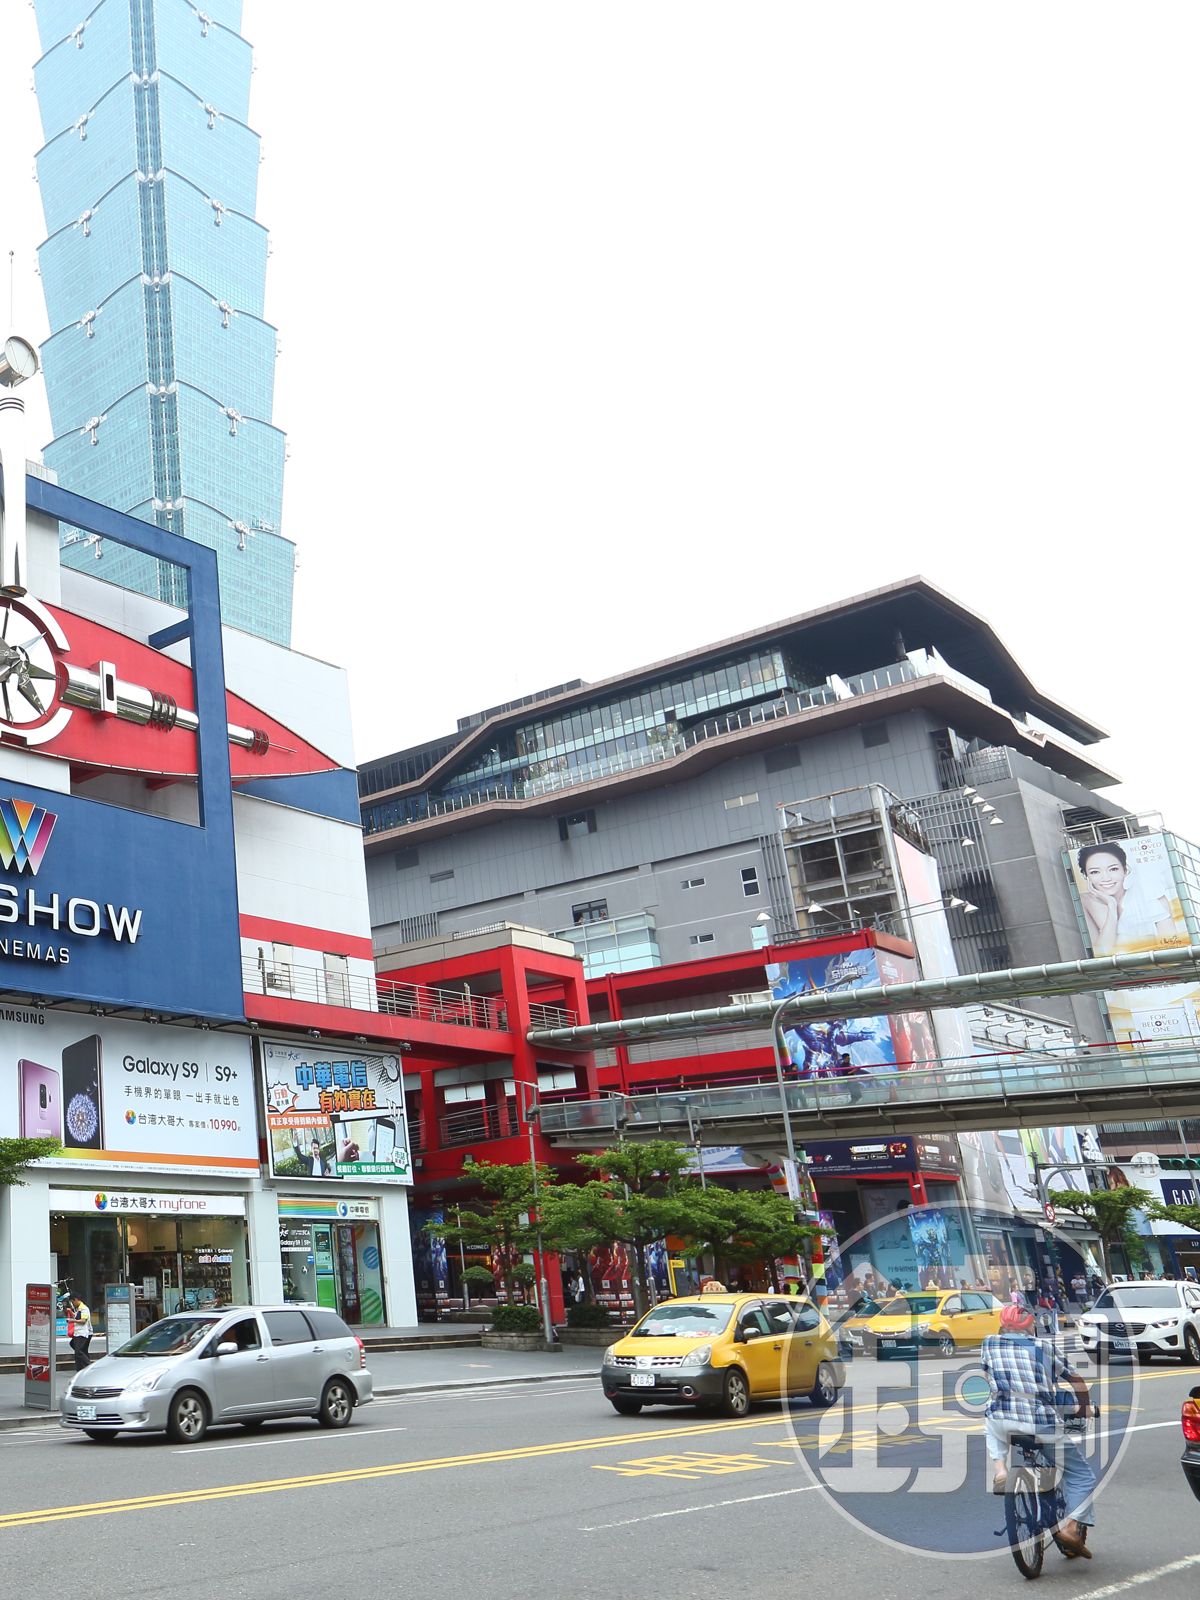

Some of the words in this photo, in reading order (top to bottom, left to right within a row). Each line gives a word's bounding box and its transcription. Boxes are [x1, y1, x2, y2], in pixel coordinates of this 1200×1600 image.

[1142, 1019, 1179, 1028] BELOVED
[1150, 1013, 1167, 1021] FOR
[122, 1055, 180, 1082] Galaxy
[182, 1064, 199, 1079] S9
[215, 1066, 238, 1082] S9+
[295, 1060, 368, 1091] 中華電信
[124, 1085, 182, 1101] 手機界的單眼
[185, 1091, 240, 1107] 一出手就出色
[319, 1087, 377, 1114] 有夠實在
[159, 1199, 207, 1212] myfone
[1171, 1189, 1196, 1206] GAP
